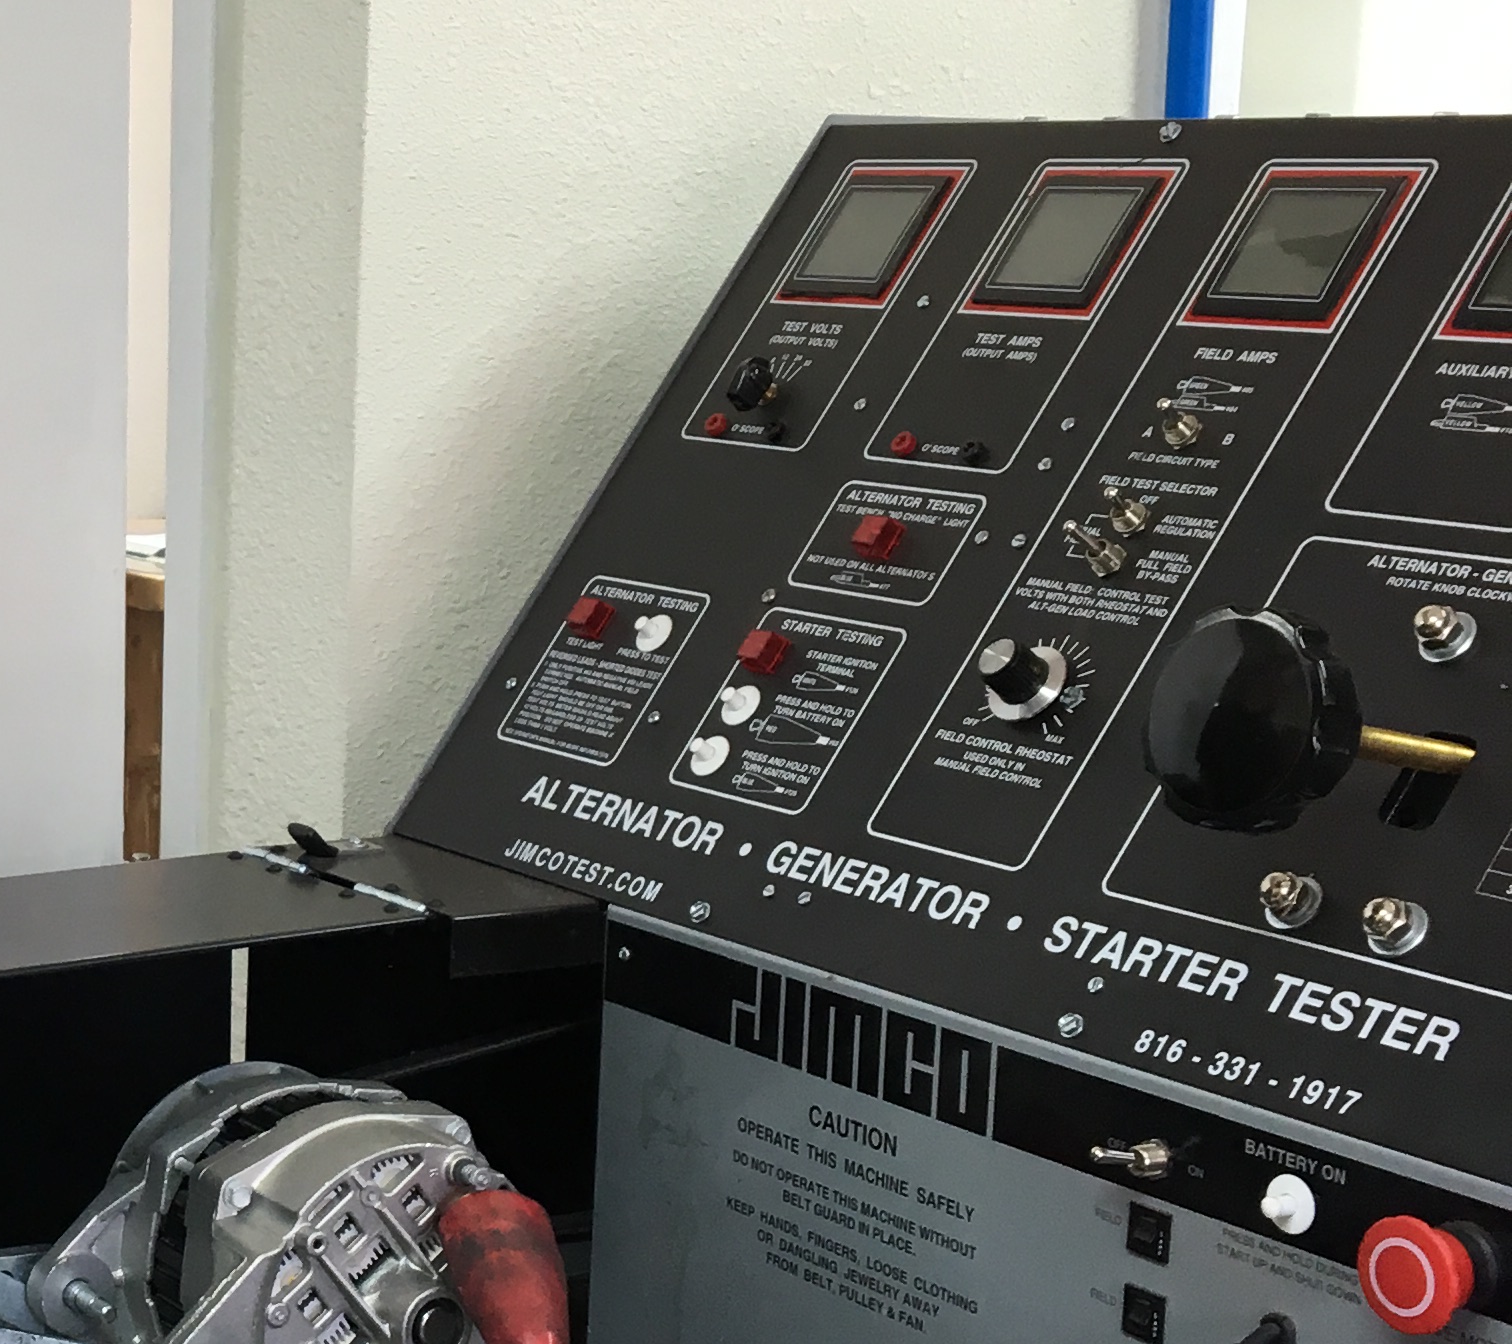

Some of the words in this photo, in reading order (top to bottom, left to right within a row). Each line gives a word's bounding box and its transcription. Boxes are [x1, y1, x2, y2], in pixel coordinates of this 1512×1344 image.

[782, 321, 809, 333] TEST
[810, 323, 843, 334] VOLTS
[975, 332, 1006, 344] TEST
[1007, 335, 1043, 347] AMPS
[1193, 347, 1234, 361] FIELD
[1236, 350, 1278, 364] AMPS
[1142, 426, 1154, 438] A
[1221, 433, 1235, 446] B
[1155, 454, 1194, 466] CIRCUIT
[1194, 458, 1220, 469] TYPE
[1099, 475, 1130, 487] FIELD
[1131, 478, 1159, 491] TEST
[1159, 481, 1218, 497] SELECTOR
[846, 489, 923, 508] ALTERNATOR
[925, 498, 976, 515] TESTING
[1139, 495, 1160, 505] OFF
[836, 504, 856, 514] TEST
[943, 517, 971, 529] LIGHT
[1161, 514, 1219, 529] AUTOMATIC
[1153, 525, 1216, 540] REGULATION
[1136, 559, 1160, 570] FULL
[1163, 562, 1192, 574] FIELD
[1149, 550, 1189, 563] MANUAL
[1367, 554, 1472, 579] ALTERNATOR
[1136, 571, 1179, 584] BY-PASS
[1386, 576, 1432, 591] ROTATE
[1431, 581, 1468, 596] KNOB
[590, 584, 655, 605] ALTERNATOR
[657, 595, 699, 613] TESTING
[1015, 586, 1045, 599] VOLTS
[1045, 591, 1067, 603] WITH
[1068, 594, 1096, 607] BOTH
[1095, 599, 1146, 615] RHEOSTAT
[1145, 606, 1168, 618] AND
[1026, 577, 1064, 591] MANUAL
[1097, 587, 1141, 602] CONTROL
[1143, 593, 1170, 605] TEST
[1027, 600, 1069, 615] ALT-GEN
[1068, 606, 1095, 619] LOAD
[1095, 611, 1141, 626] CONTROL
[781, 618, 833, 638] STARTER
[836, 629, 884, 647] TESTING
[806, 650, 842, 664] STARTER
[841, 656, 879, 671] IGNITION
[816, 662, 856, 678] TERMINAL
[773, 705, 795, 716] TURN
[795, 709, 832, 725] BATTERY
[831, 718, 846, 728] ON
[775, 694, 802, 707] PRESS
[801, 700, 820, 711] AND
[819, 704, 843, 715] HOLD
[843, 708, 855, 718] TO
[934, 728, 966, 744] FIELD
[965, 735, 1013, 754] CONTROL
[1014, 746, 1074, 767] RHEOSTAT
[1044, 734, 1065, 744] MAX
[741, 761, 763, 773] TURN
[762, 766, 797, 782] IGNITION
[742, 749, 769, 763] PRESS
[767, 756, 786, 767] AND
[785, 761, 809, 773] HOLD
[808, 765, 821, 776] TO
[934, 756, 972, 773] MANUAL
[971, 764, 999, 779] FIELD
[998, 771, 1043, 789] CONTROL
[963, 751, 989, 764] USED
[988, 756, 1018, 770] ONLY
[504, 838, 664, 905] JIMCOTEST.COM
[521, 774, 725, 858] ALTERNATOR
[765, 839, 993, 931] GENERATOR
[1043, 915, 1250, 1002] STARTER
[1267, 973, 1462, 1062] TESTER
[1134, 1029, 1188, 1064] 816
[1207, 1050, 1263, 1087] 331
[1288, 1074, 1363, 1116] 1917
[808, 1105, 898, 1157] CAUTION
[738, 1117, 799, 1155] OPERATE
[806, 1143, 837, 1169] THIS
[844, 1158, 909, 1198] MACHINE
[916, 1186, 975, 1223] SAFELY
[1244, 1139, 1319, 1175] BATTERY
[1322, 1164, 1347, 1185] ON
[733, 1149, 749, 1166] DO
[750, 1157, 774, 1177] NOT
[776, 1167, 830, 1200] OPERATE
[832, 1190, 859, 1212] THIS
[860, 1201, 916, 1236] MACHINE
[919, 1225, 977, 1260] WITHOUT
[782, 1189, 812, 1213] BELT
[813, 1202, 856, 1230] GUARD
[858, 1220, 870, 1237] IN
[726, 1196, 755, 1218] KEEP
[866, 1256, 908, 1284] LOOSE
[913, 1276, 978, 1315] CLOTHING
[757, 1228, 774, 1246] OR
[779, 1239, 838, 1274] DANGLING
[843, 1267, 900, 1301] JEWELRY
[902, 1293, 940, 1318] AWAY
[766, 1252, 798, 1277] FROM
[838, 1283, 884, 1312] PULLEY
[885, 1306, 895, 1320] &
